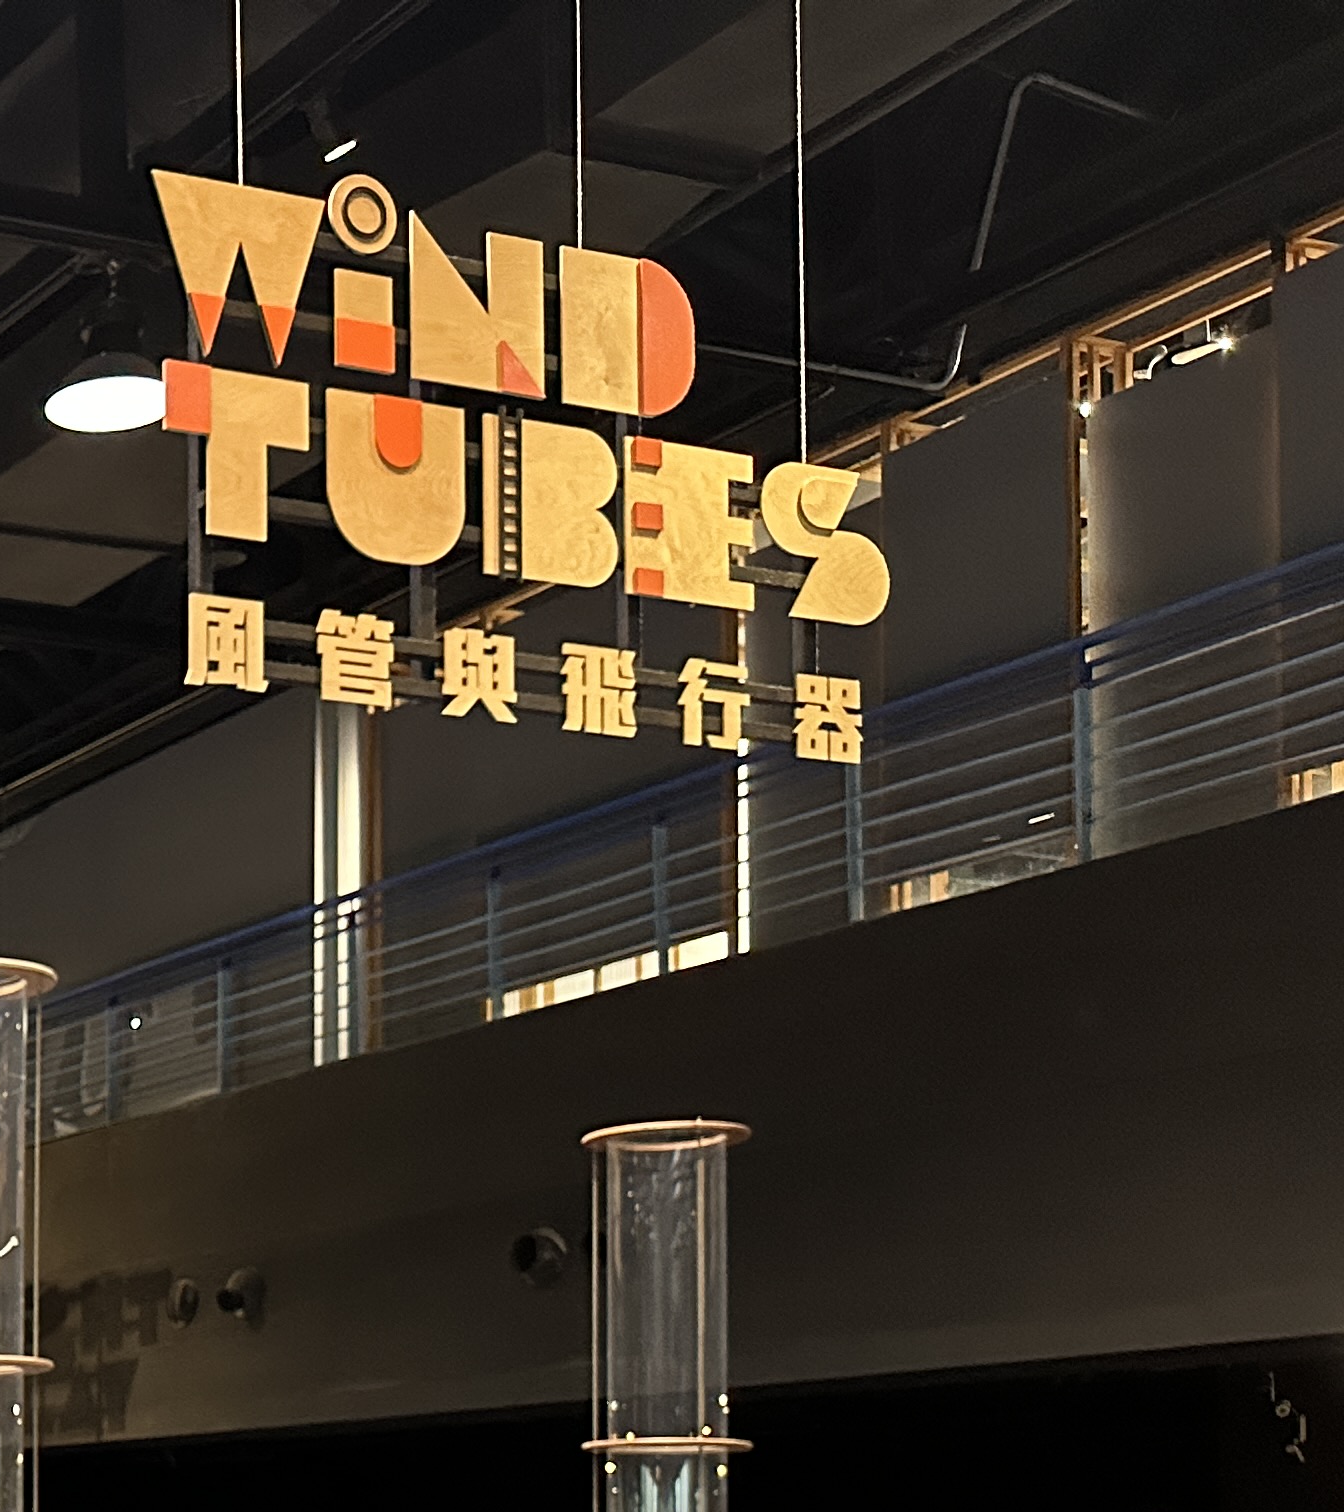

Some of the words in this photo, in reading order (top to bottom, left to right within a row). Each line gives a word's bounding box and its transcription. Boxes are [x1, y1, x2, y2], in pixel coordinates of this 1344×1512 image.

[161, 358, 891, 626] TUBES
[183, 591, 863, 765] 風管與飛行器
